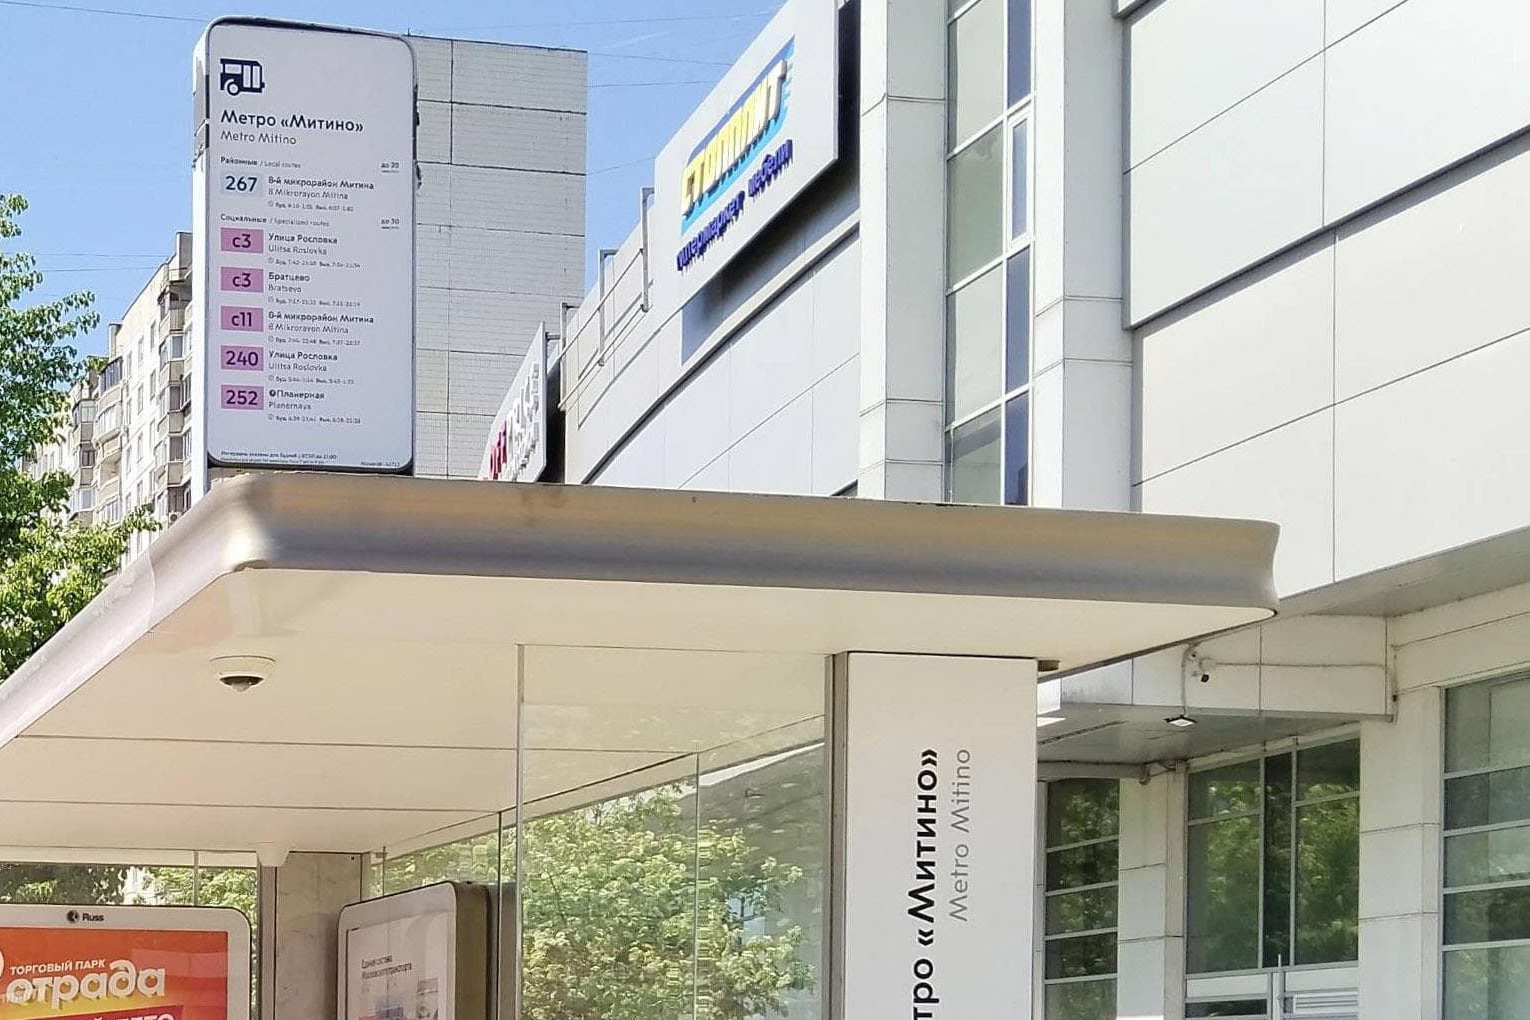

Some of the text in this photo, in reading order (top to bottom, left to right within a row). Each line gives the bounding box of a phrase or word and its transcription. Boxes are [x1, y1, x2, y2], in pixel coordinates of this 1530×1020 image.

[220, 109, 364, 132] Метро «Митино»
[220, 130, 297, 145] Metro Mitino
[220, 156, 258, 166] Районные
[225, 175, 258, 192] 267
[284, 178, 338, 188] микрорайон
[340, 180, 374, 190] Митина
[275, 188, 320, 199] Mikrorayon
[322, 191, 349, 200] Mitina
[220, 213, 267, 224] Социальные
[232, 234, 252, 249] с3
[268, 233, 338, 244] Улица Рословка
[268, 245, 327, 255] Ulitsa Roslovka
[232, 272, 252, 288] с3
[268, 272, 310, 281] Братцево
[268, 284, 302, 293] Bratsevo
[231, 311, 252, 327] с11
[284, 312, 338, 323] микрорайон
[340, 314, 374, 323] Митина
[322, 325, 349, 334] Mitina
[226, 351, 259, 366] 240
[268, 351, 338, 361] Улица Рословка
[268, 362, 327, 372] Ulitsa Roslovka
[226, 390, 259, 405] 252
[276, 389, 325, 399] Планерная
[268, 402, 312, 410] Planernaya
[949, 749, 971, 922] Metro Mitino
[907, 749, 938, 946] «Митино»
[82, 913, 104, 922] Russ
[10, 959, 106, 976] ТОРГОВЫЙ ПАРК
[6, 959, 167, 1010] отрада
